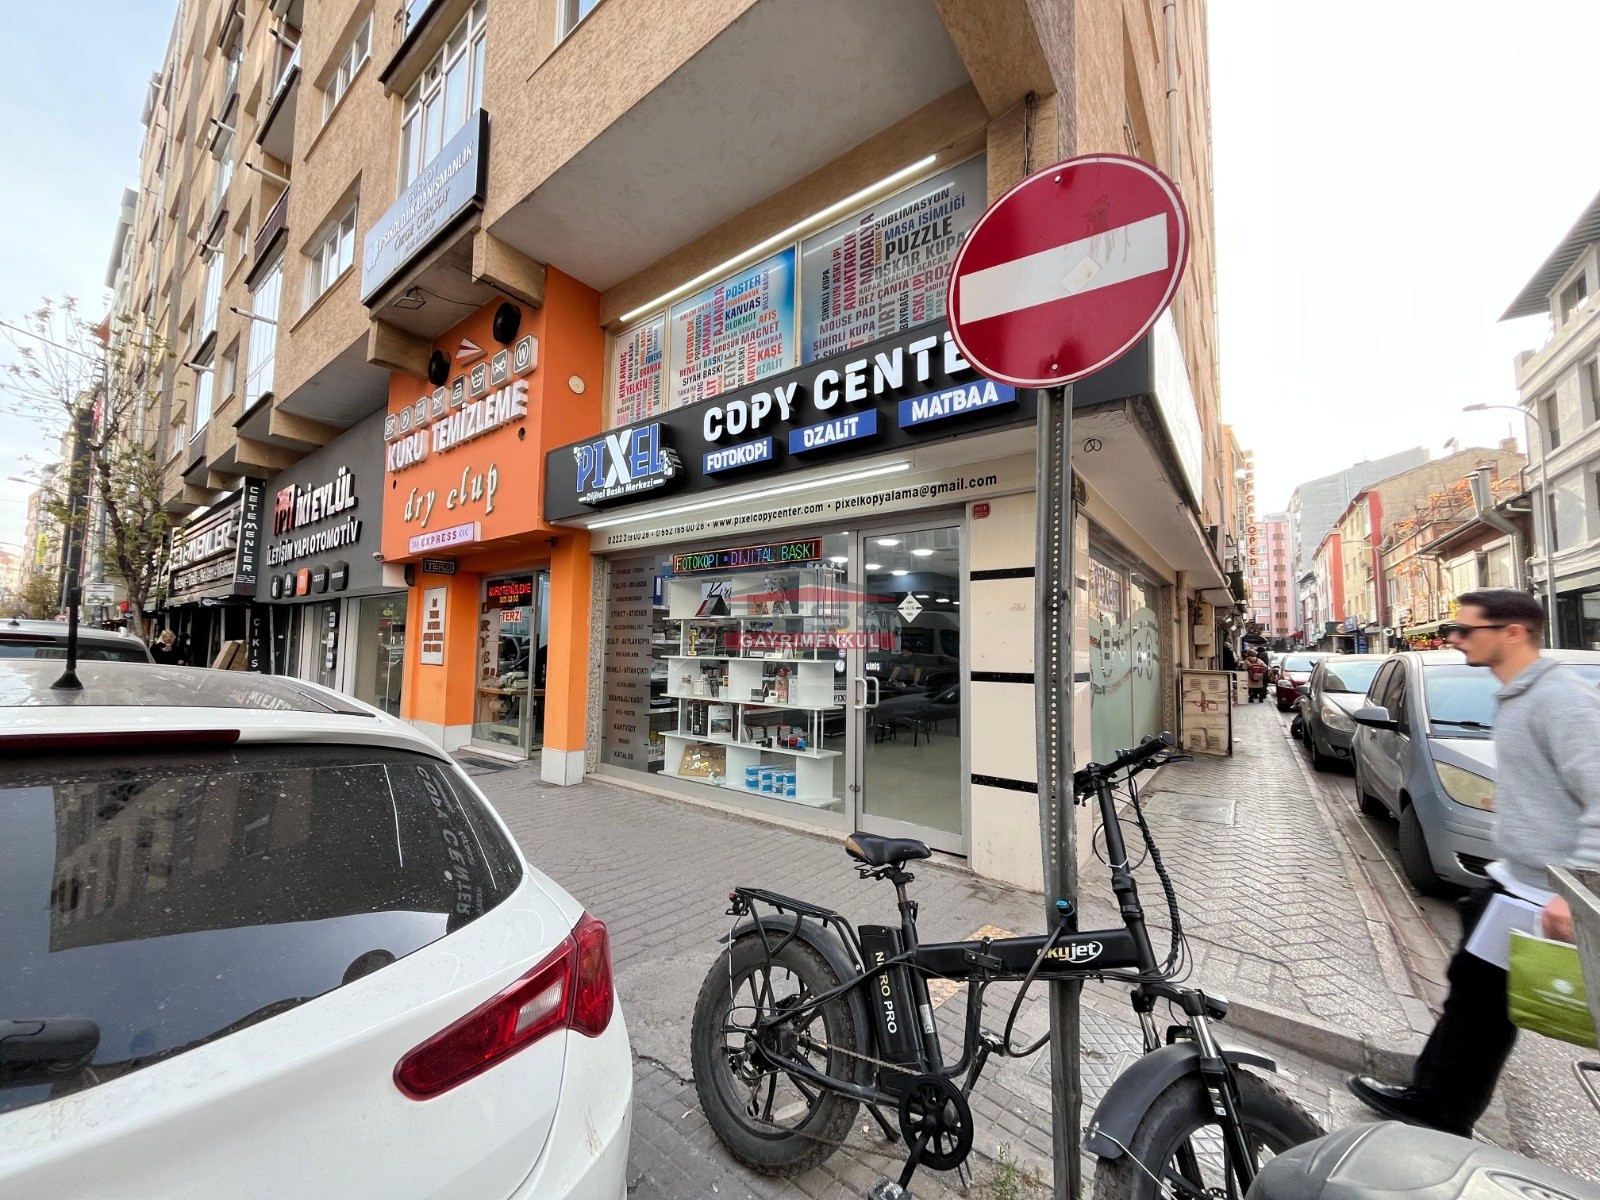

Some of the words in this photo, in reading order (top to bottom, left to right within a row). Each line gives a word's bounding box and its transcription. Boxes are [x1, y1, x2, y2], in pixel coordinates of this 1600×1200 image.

[884, 218, 915, 242] MASA
[918, 192, 965, 226] İSİMLİĞİ
[860, 212, 875, 286] MADALYA
[874, 250, 920, 281] OSKAR
[925, 231, 966, 260] KUPA
[885, 216, 953, 261] PUZZLE
[725, 274, 761, 300] POSTER
[843, 231, 857, 311] ANAHTARLIK
[713, 285, 725, 337] AJANDA
[725, 296, 761, 321] KANVAS
[858, 293, 875, 307] BEZ
[877, 279, 909, 301] ÇANTA
[912, 293, 925, 322] ASKI
[725, 311, 757, 332] BLOKNOT
[741, 320, 780, 345] MAGNET
[819, 313, 853, 335] MOUSE
[855, 305, 876, 322] PAD
[849, 319, 876, 339] KUPA
[757, 332, 783, 348] MATBAA
[757, 342, 783, 363] KAŞE
[619, 351, 629, 399] KIRLANGIÇ
[703, 364, 723, 379] BASKI
[747, 341, 756, 382] ARTVİZİT
[625, 378, 647, 396] YELKEN
[703, 382, 798, 442] COPY
[813, 330, 973, 411] CENTE
[911, 382, 998, 422] MATBAA
[388, 431, 428, 473] KURU
[432, 379, 528, 453] TEMİZLEME
[403, 487, 436, 528] dry
[446, 463, 499, 516] clup
[835, 474, 997, 511] pixelkopyalama@gmail.com
[421, 529, 458, 548] EXPRESS
[875, 951, 891, 996] NIRO
[883, 1000, 897, 1034] PRO
